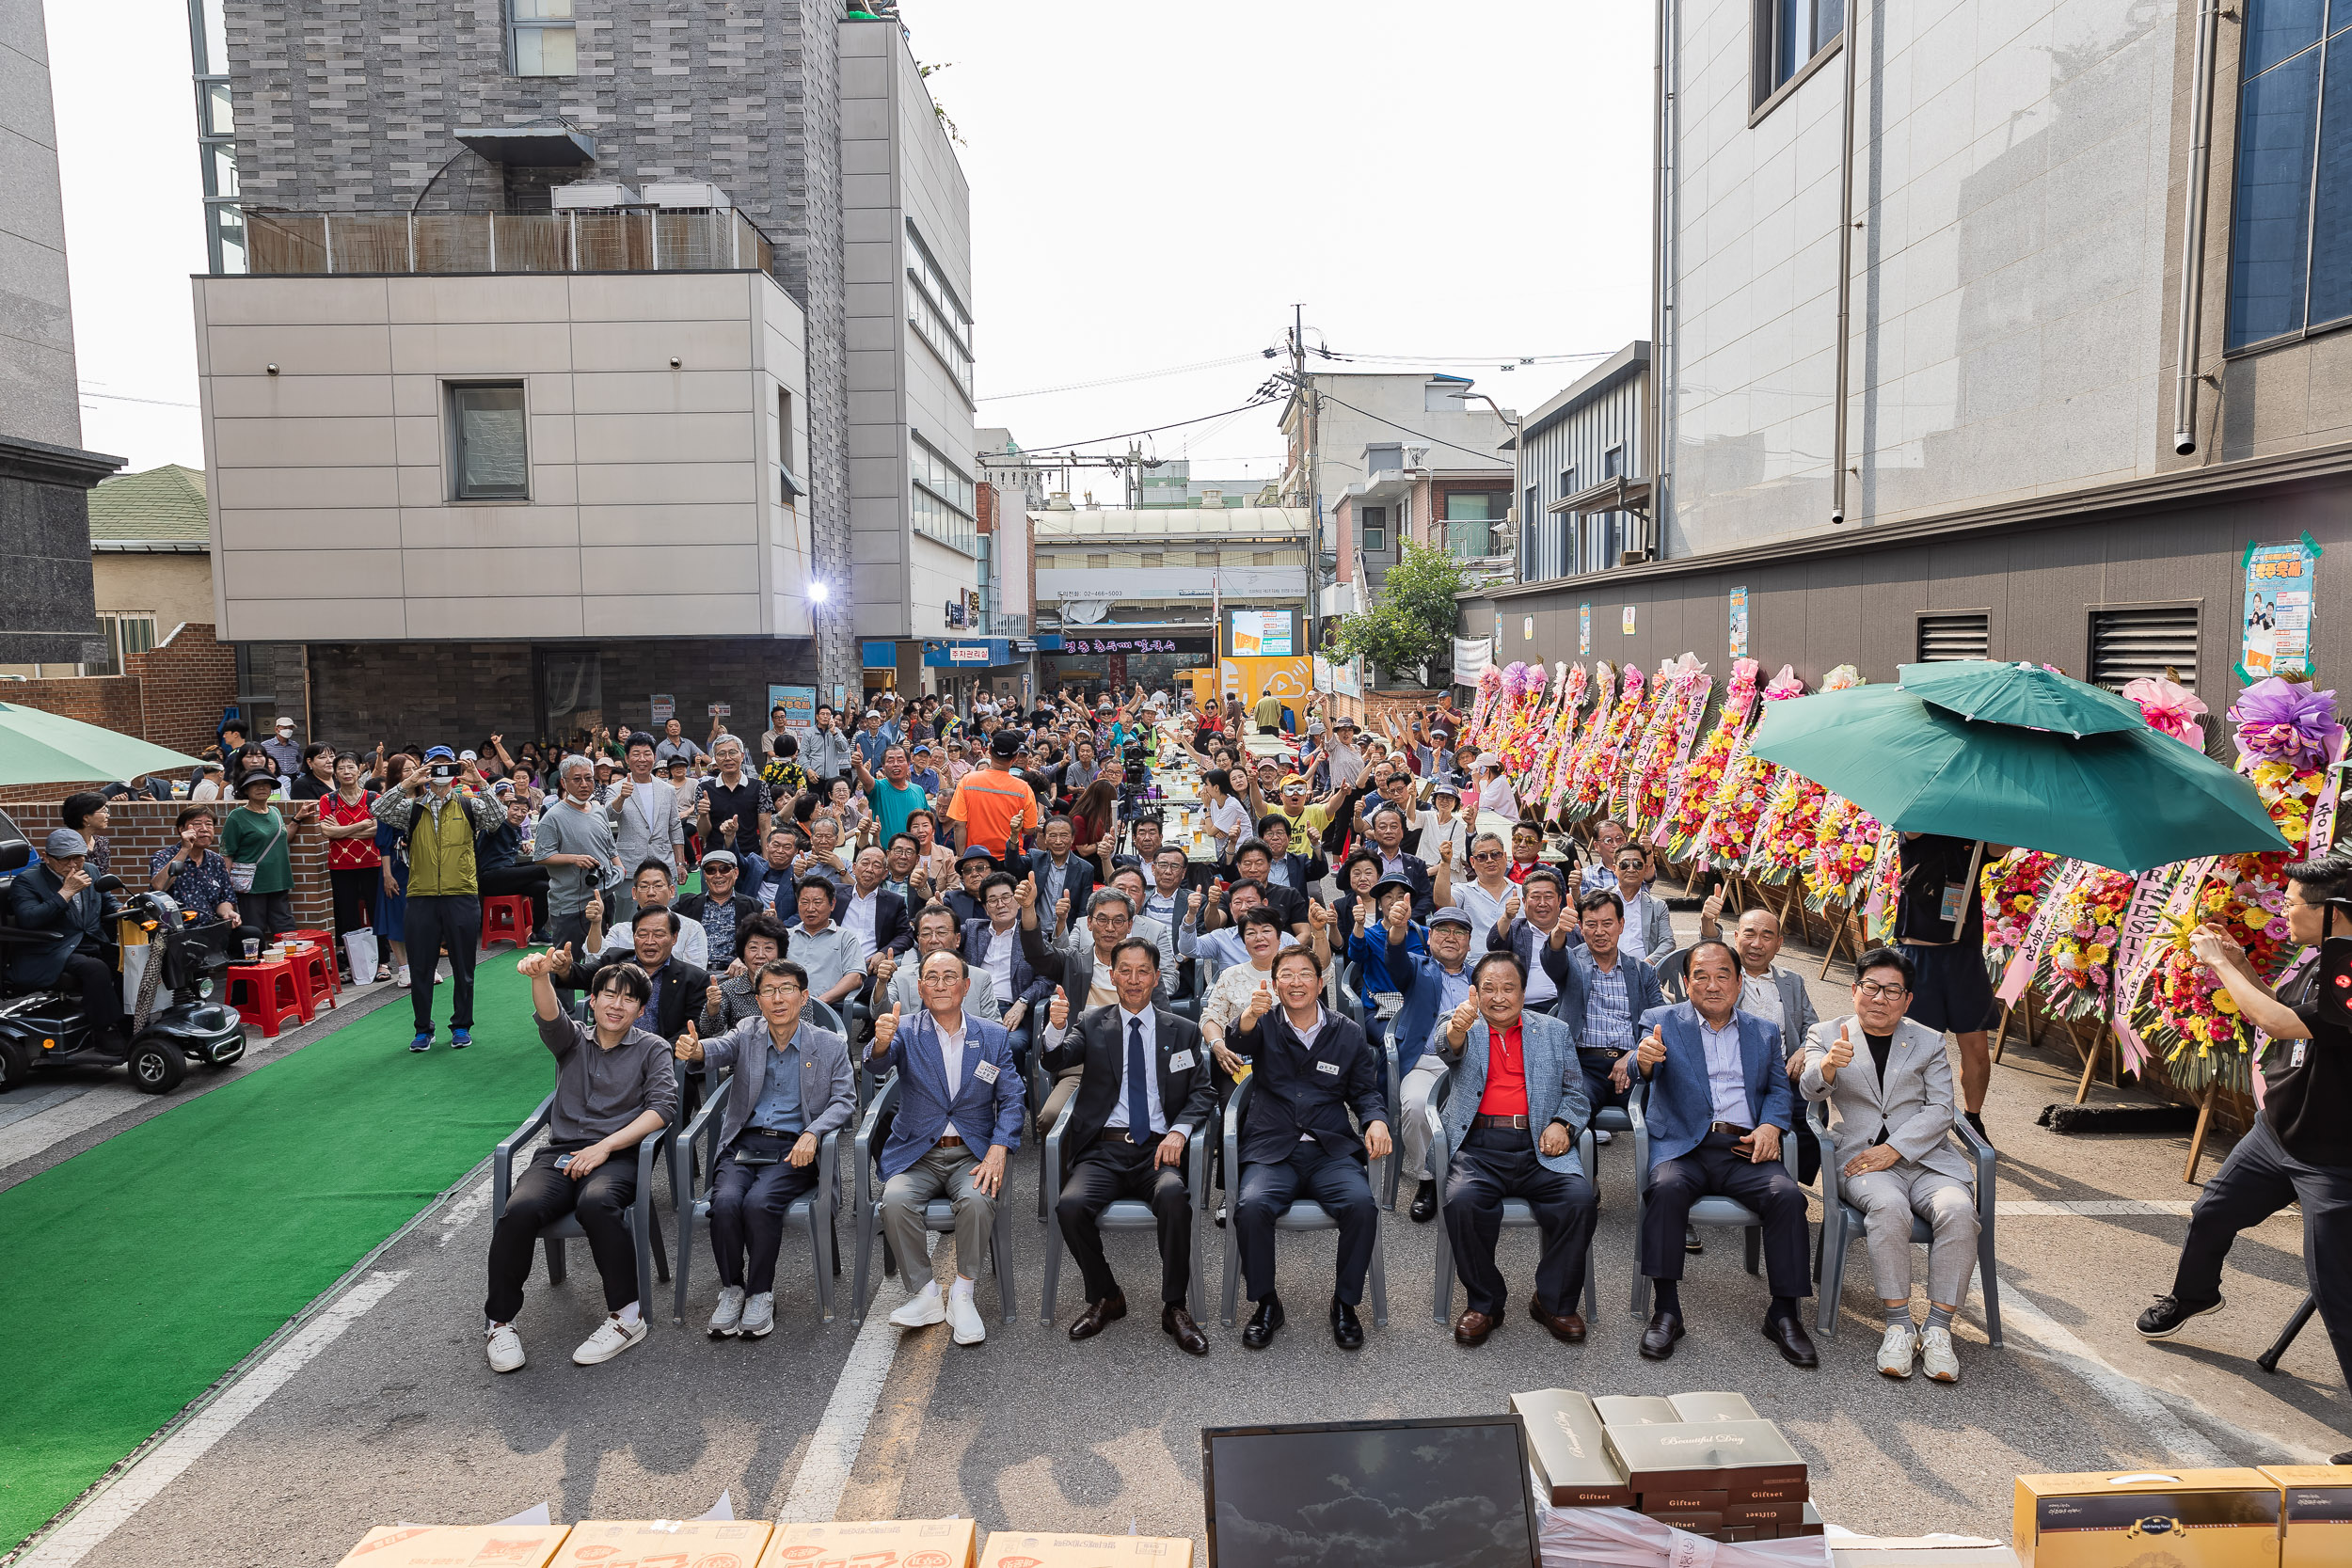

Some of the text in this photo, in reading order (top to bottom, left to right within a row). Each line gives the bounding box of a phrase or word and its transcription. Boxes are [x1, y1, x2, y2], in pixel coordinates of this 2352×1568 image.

[2255, 561, 2302, 579] 맥주축제
[1065, 640, 1175, 653] 명동 홍두깨 칼국수
[2117, 887, 2157, 1015] FESTIVAL
[1661, 1433, 1745, 1446] Beautiful Day
[1745, 1511, 1777, 1519] Giftset
